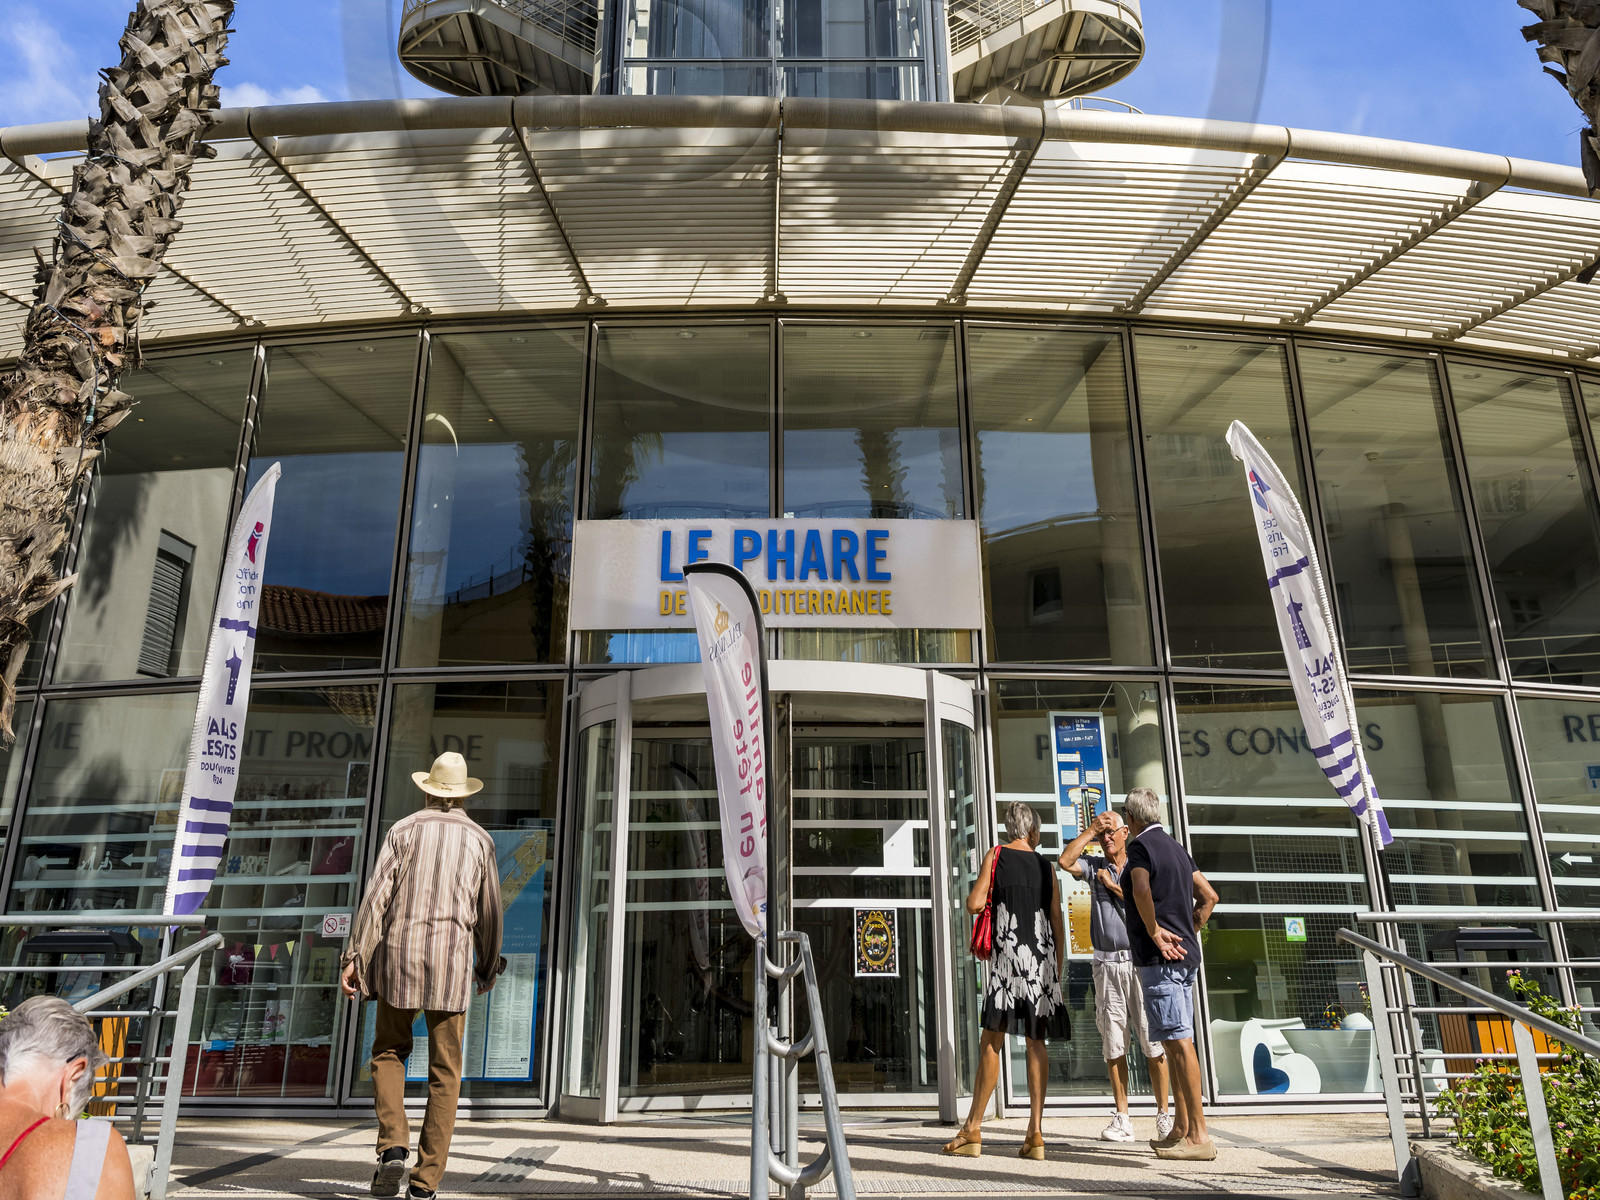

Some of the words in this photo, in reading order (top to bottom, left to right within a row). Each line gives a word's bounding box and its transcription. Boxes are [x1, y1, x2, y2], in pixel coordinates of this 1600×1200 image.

[660, 529, 713, 582] LE
[734, 529, 892, 582] PHARE
[660, 590, 687, 615] DE
[760, 589, 893, 615] DITERRANEE
[1182, 729, 1211, 758] ES
